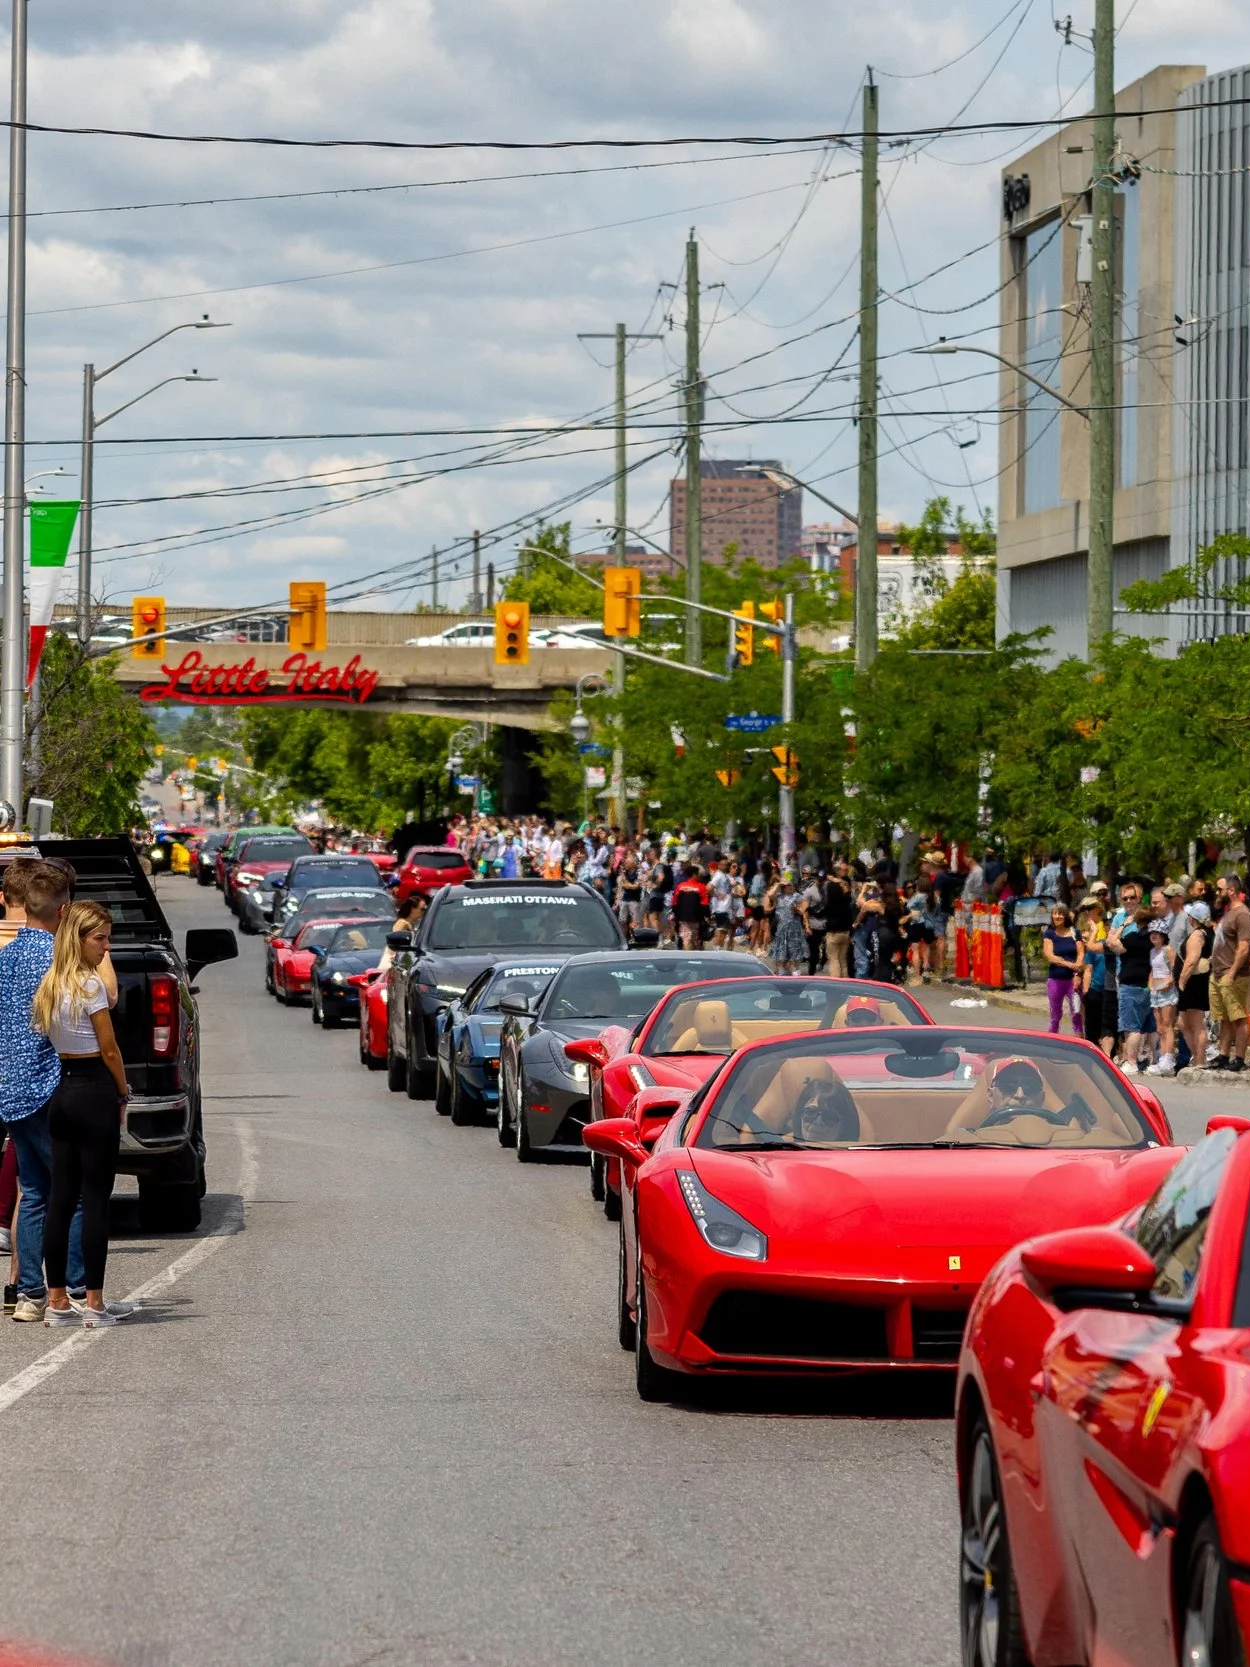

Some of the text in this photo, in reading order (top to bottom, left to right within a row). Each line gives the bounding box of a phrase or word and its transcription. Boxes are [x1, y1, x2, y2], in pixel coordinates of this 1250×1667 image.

[139, 650, 379, 704] Little Italy
[463, 895, 577, 907] MASERATI OTTAWA
[504, 967, 560, 978] PRESTON
